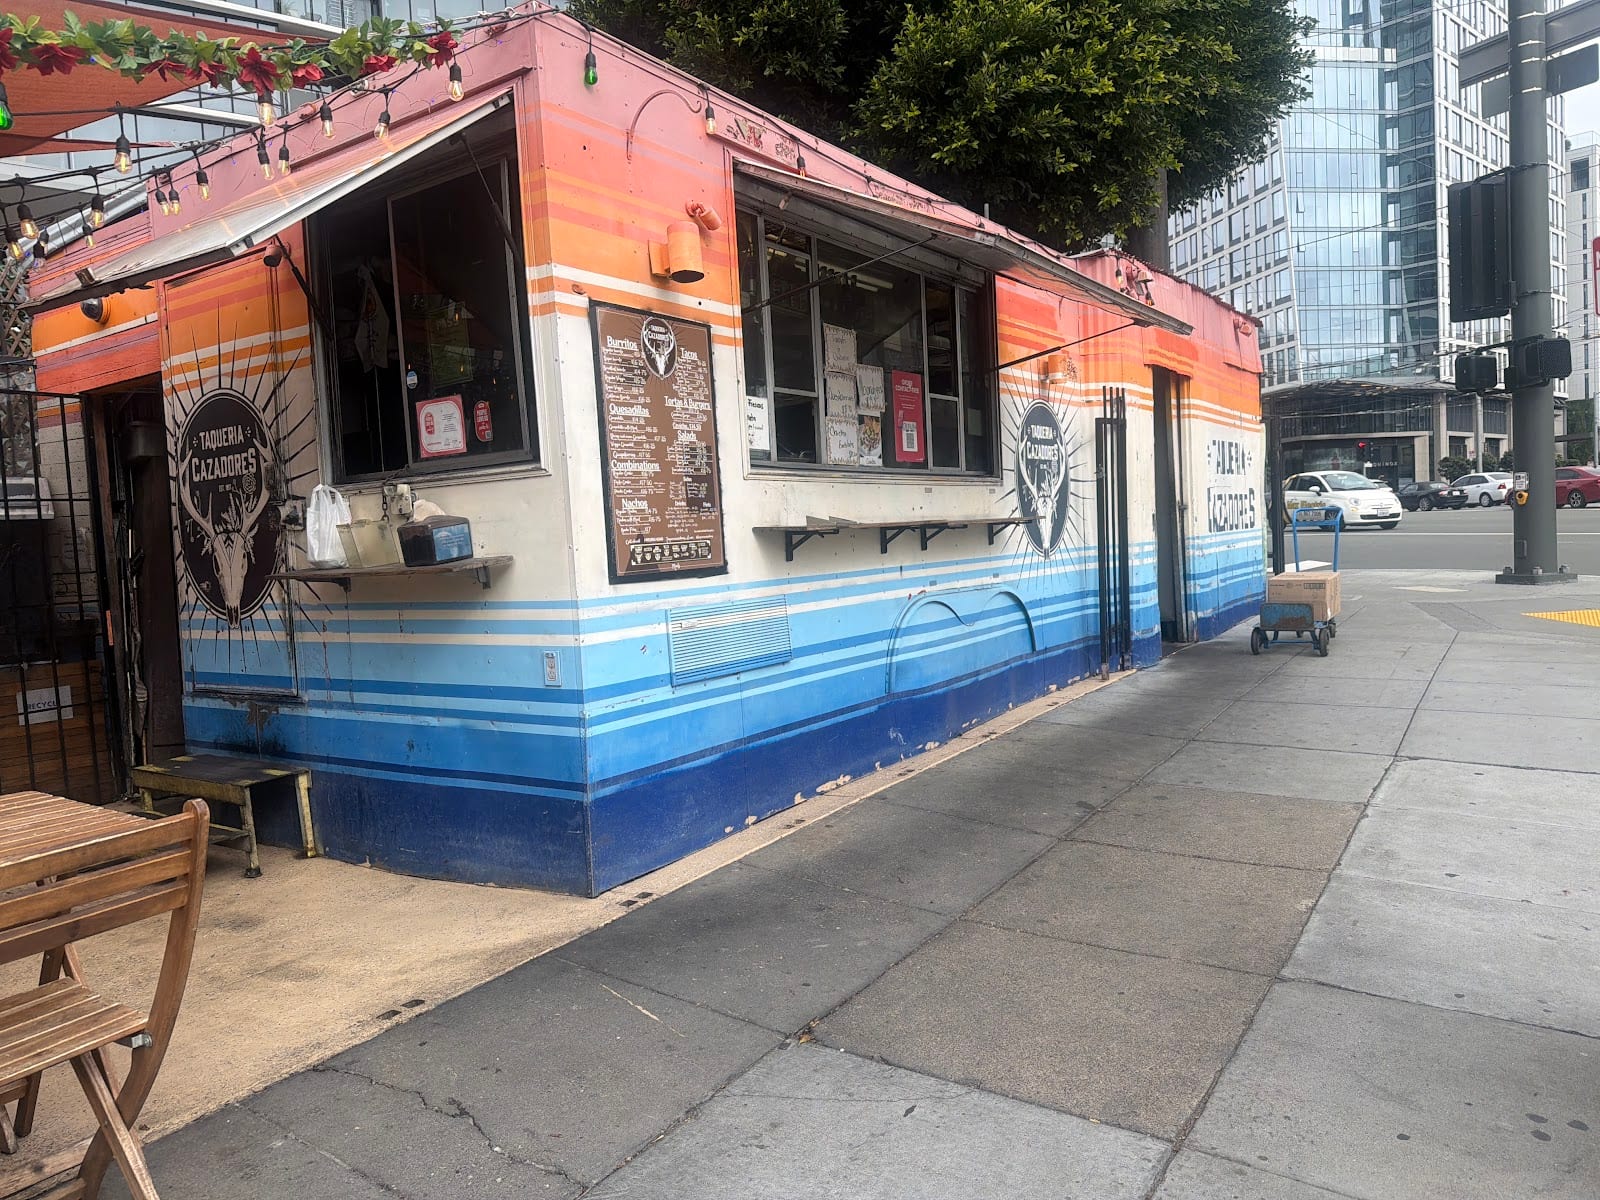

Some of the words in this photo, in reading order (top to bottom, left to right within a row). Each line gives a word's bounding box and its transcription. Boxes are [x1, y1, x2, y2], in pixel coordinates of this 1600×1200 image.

[607, 336, 638, 349] Burritos
[681, 348, 698, 359] Tacos
[609, 403, 650, 416] Quesadillas
[664, 396, 683, 407] Tortas
[689, 400, 711, 411] Burgers
[199, 425, 244, 451] TAQUERIA
[677, 431, 697, 440] Salads
[1031, 425, 1053, 440] TAQUERIA
[1026, 441, 1059, 461] CAZADORES
[191, 448, 257, 483] CAZADORES
[611, 460, 660, 471] Combinations
[621, 498, 648, 508] Nachos
[1207, 487, 1255, 533] CAZADORES
[27, 700, 57, 710] RECYCL
